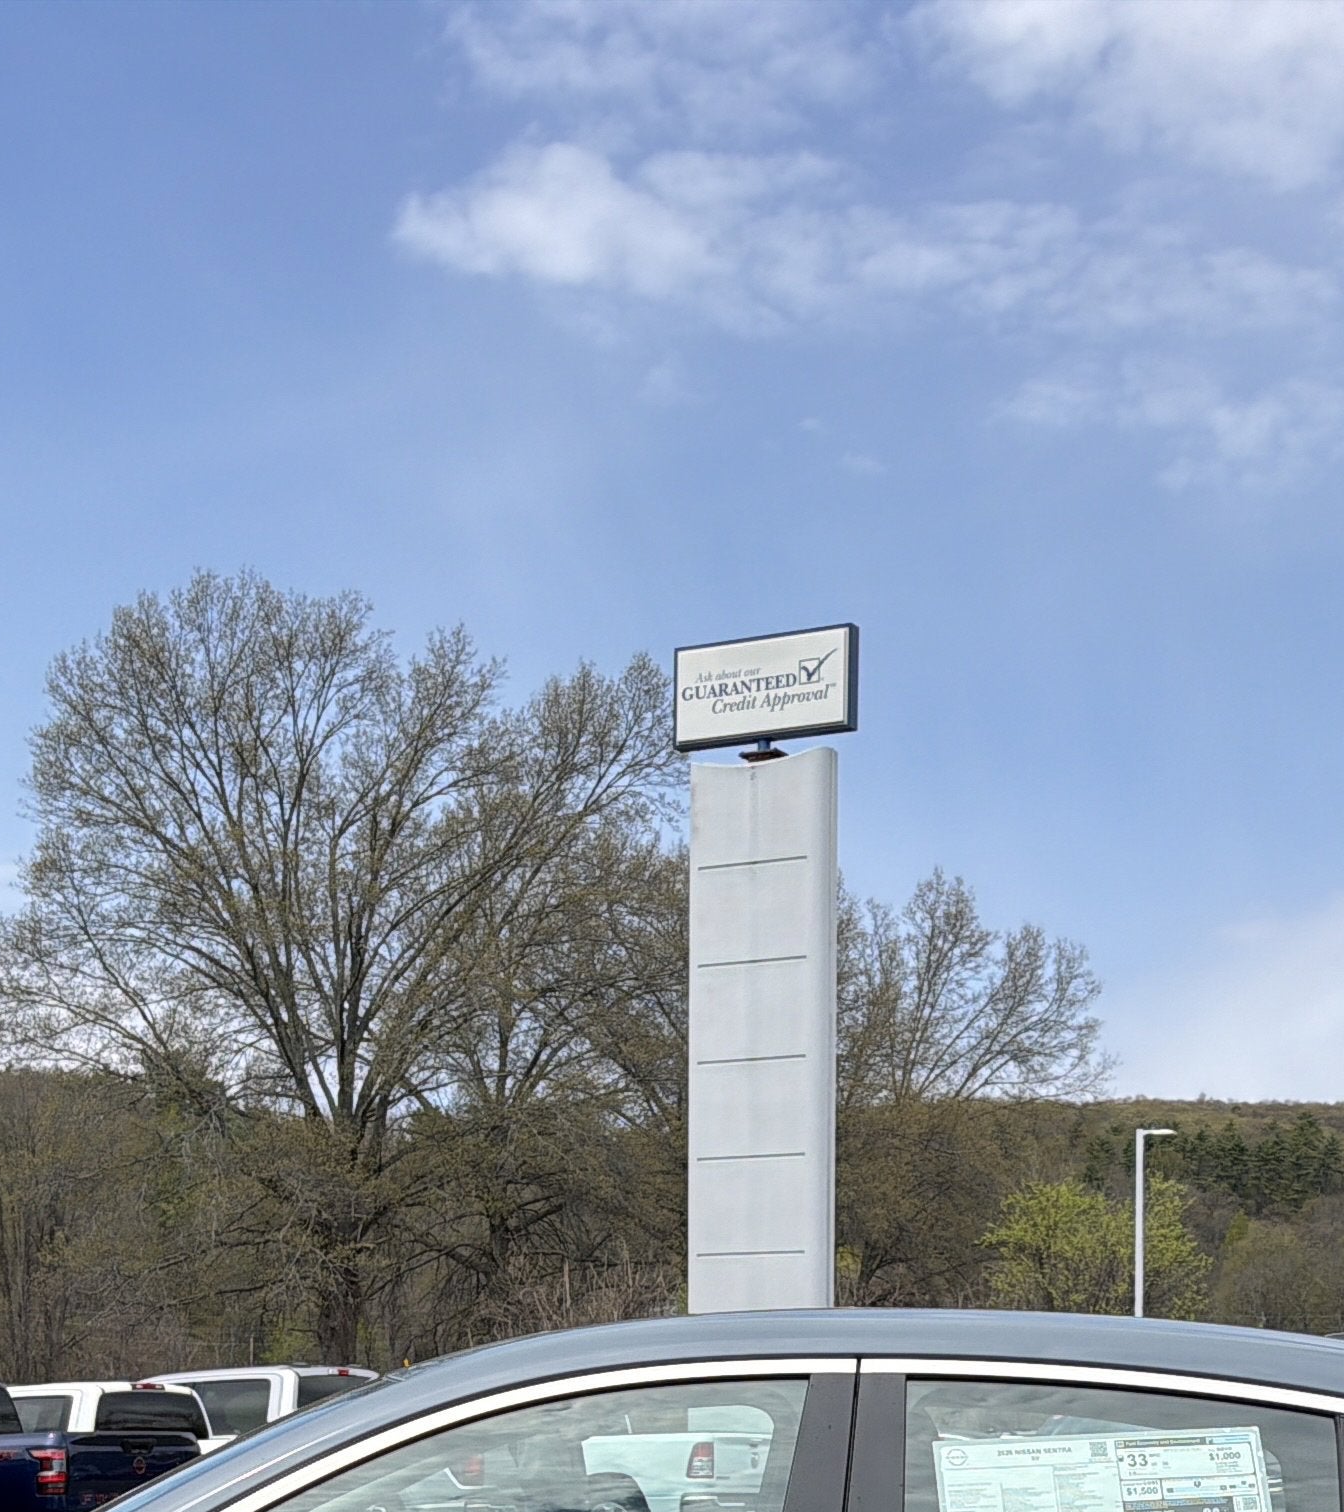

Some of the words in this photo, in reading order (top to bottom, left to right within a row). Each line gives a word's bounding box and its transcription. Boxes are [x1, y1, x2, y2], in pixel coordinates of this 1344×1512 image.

[695, 671, 713, 684] Ask
[715, 668, 742, 682] about
[744, 667, 761, 677] our
[681, 673, 797, 702] GUARANTEED
[712, 696, 757, 715] Credit
[1126, 1453, 1148, 1467] 33
[1208, 1452, 1241, 1461] $1,000
[1126, 1486, 1158, 1496] $1,500
